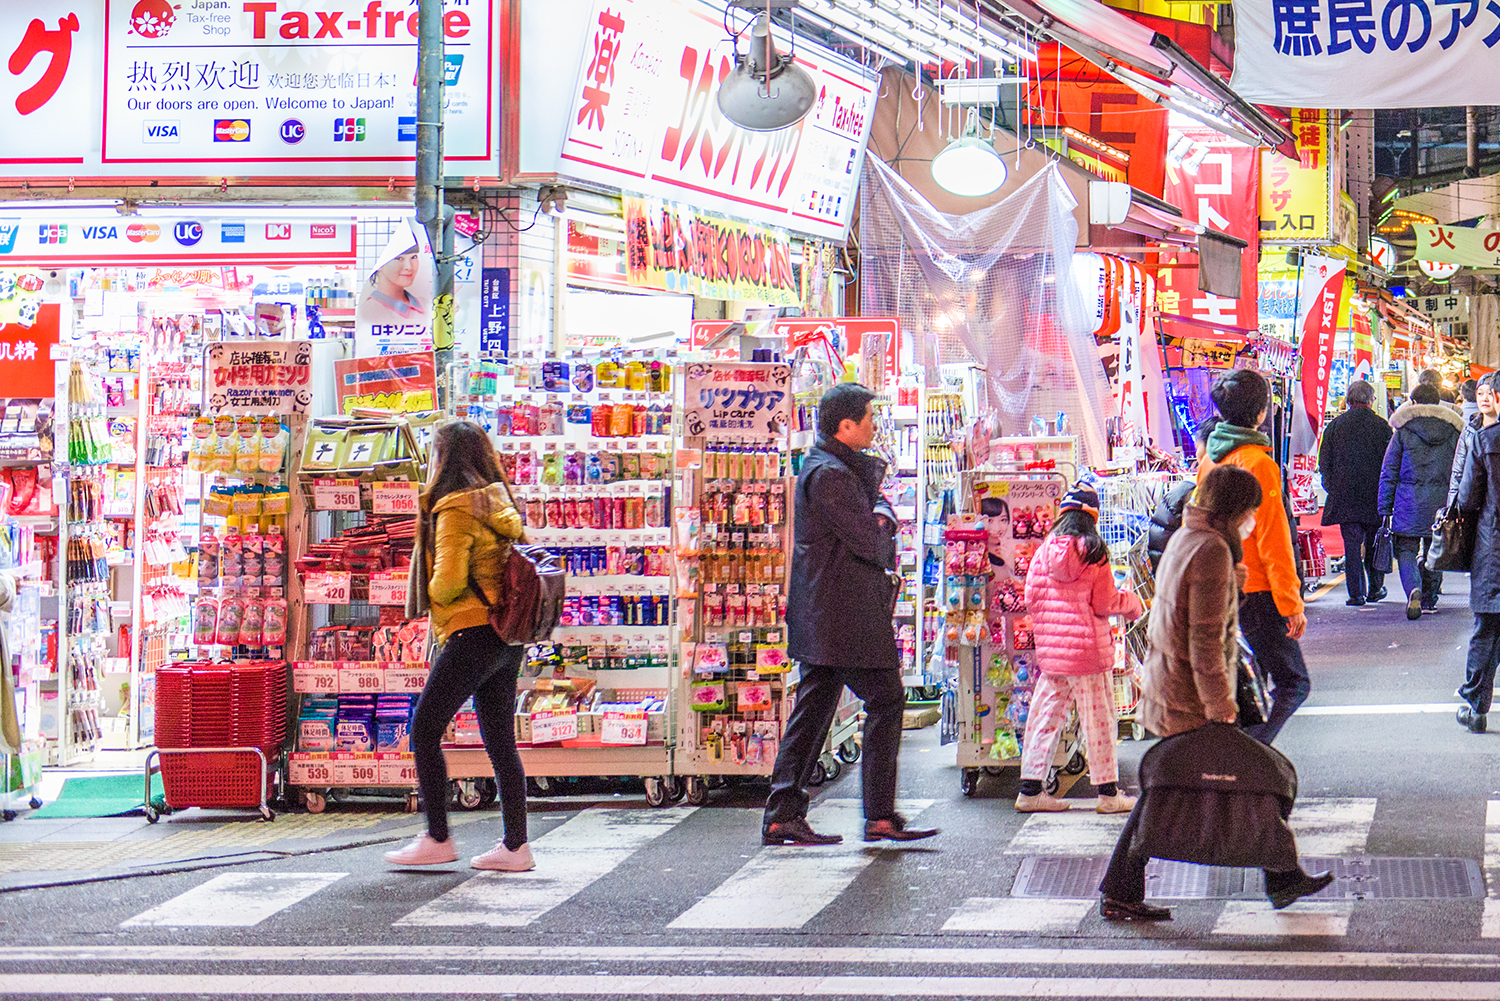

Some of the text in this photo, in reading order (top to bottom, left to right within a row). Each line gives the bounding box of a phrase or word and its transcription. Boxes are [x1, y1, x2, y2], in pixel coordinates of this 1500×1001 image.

[191, 0, 231, 11] Japan.
[186, 12, 231, 24] Tax-free
[202, 25, 231, 36] Shop
[577, 6, 625, 132] 薬
[127, 61, 397, 91] 热烈欢迎 欢迎您光临日本!
[127, 97, 151, 110] Our
[156, 97, 193, 110] doors
[197, 100, 219, 110] are
[223, 100, 259, 113] open.
[265, 96, 326, 110] Welcome
[333, 97, 346, 110] to
[350, 96, 395, 112] Japan!
[831, 95, 865, 138] Tax-free
[147, 125, 178, 138] VISA
[333, 125, 366, 136] JCB
[1270, 154, 1291, 213] ラザ
[1280, 215, 1315, 231] 入口
[39, 227, 67, 239] JCB
[82, 226, 118, 239] VISA
[267, 224, 290, 238] DC
[372, 324, 427, 336] ロキソニン
[213, 365, 311, 388] 女性用カミソリ
[227, 388, 296, 397] Razor for women
[700, 384, 785, 411] リップケア
[713, 410, 755, 419] Lip care
[334, 494, 355, 505] 350
[391, 499, 413, 510] 1050
[314, 677, 334, 688] 792
[358, 677, 379, 688] 980
[404, 677, 425, 688] 298
[551, 725, 573, 737] 3127
[308, 768, 329, 779] 539
[352, 768, 374, 779] 509
